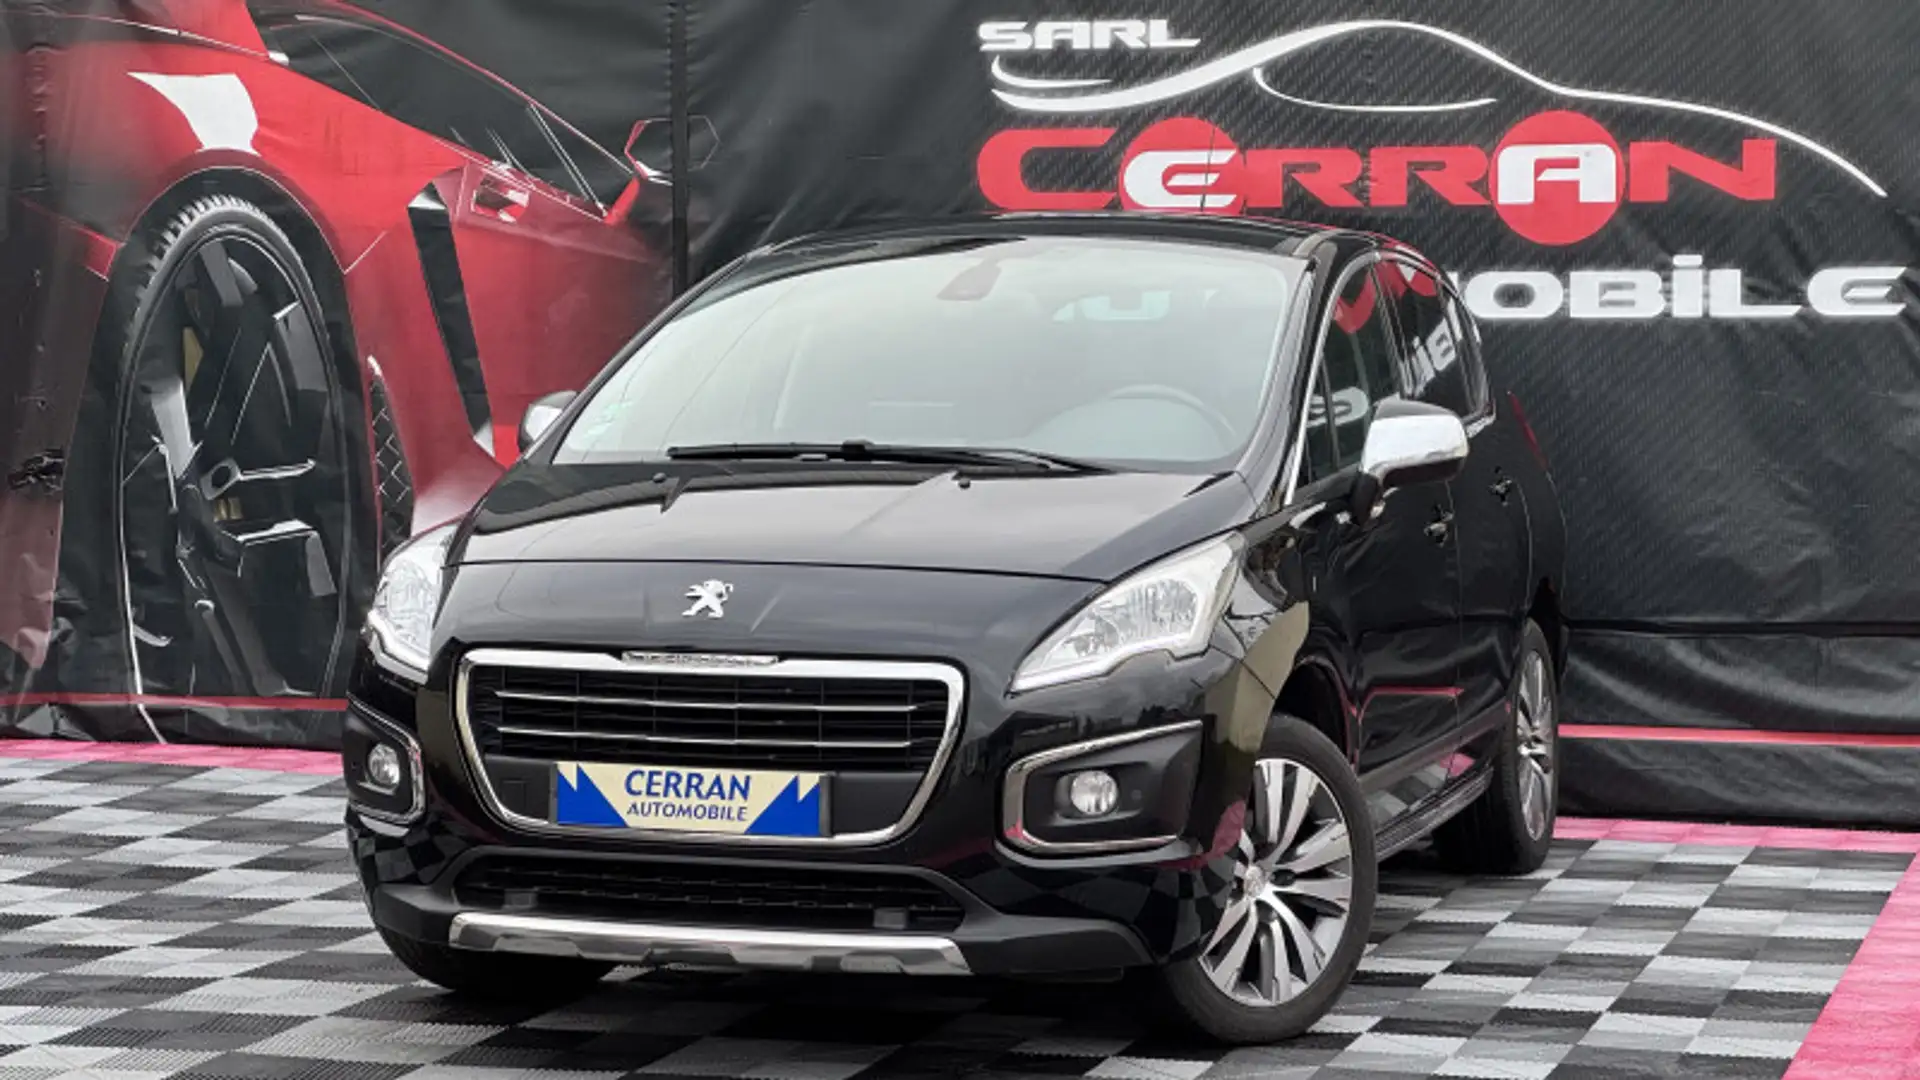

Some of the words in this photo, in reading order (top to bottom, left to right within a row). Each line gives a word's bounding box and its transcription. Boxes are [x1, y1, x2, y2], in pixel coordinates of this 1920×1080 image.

[978, 19, 1201, 51] SARL
[977, 122, 1777, 211] CERRAN
[624, 769, 752, 801] CERRAN
[626, 801, 747, 822] AUTOMOBILE
